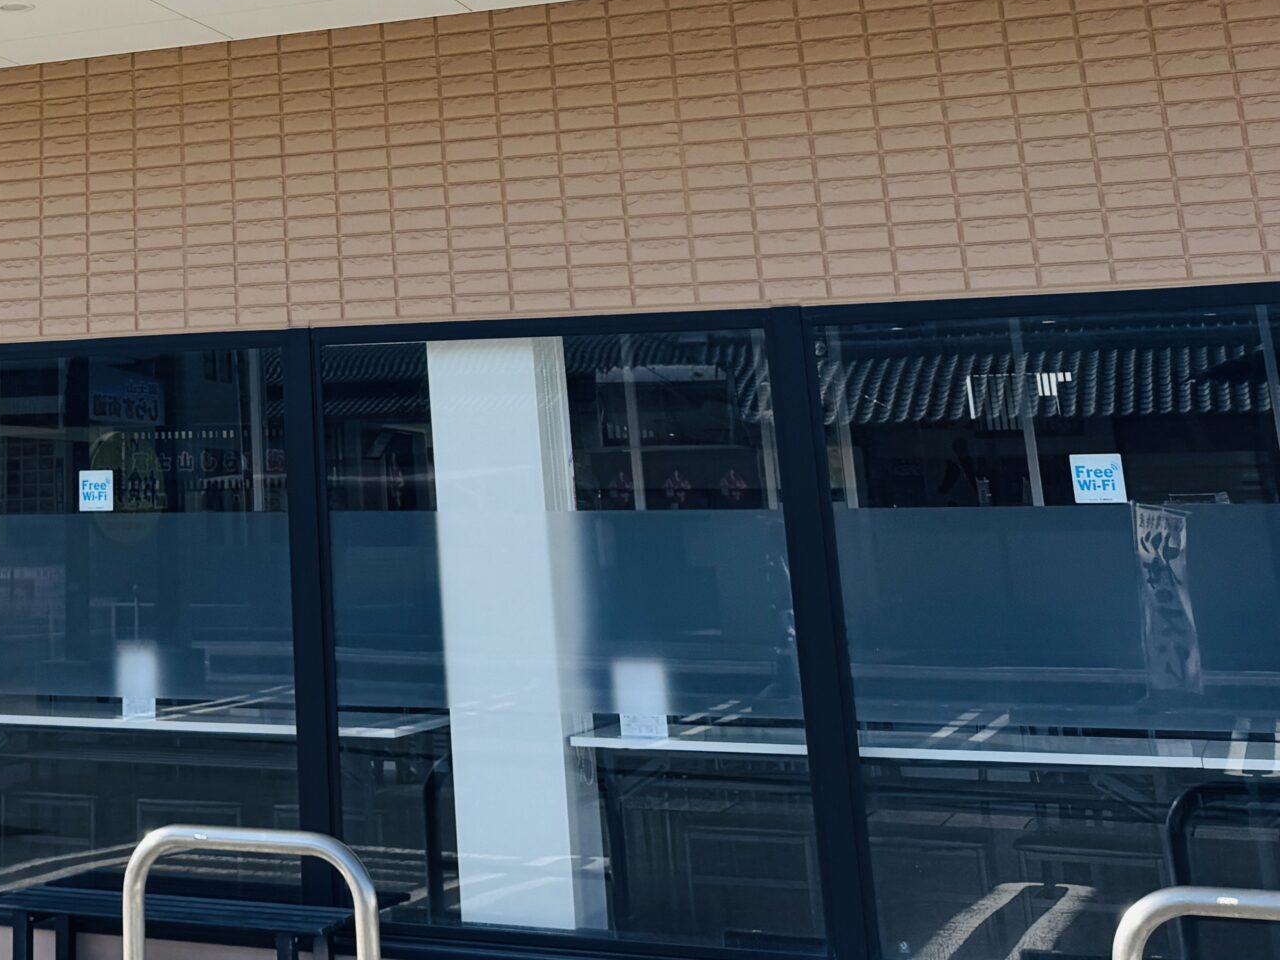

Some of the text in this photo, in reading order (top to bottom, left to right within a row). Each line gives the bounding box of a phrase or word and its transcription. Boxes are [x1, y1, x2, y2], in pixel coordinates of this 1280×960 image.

[1075, 465, 1113, 478] Free
[82, 480, 107, 490] Free
[1077, 479, 1116, 491] Wi-Fi
[82, 491, 107, 501] Wi-Fi
